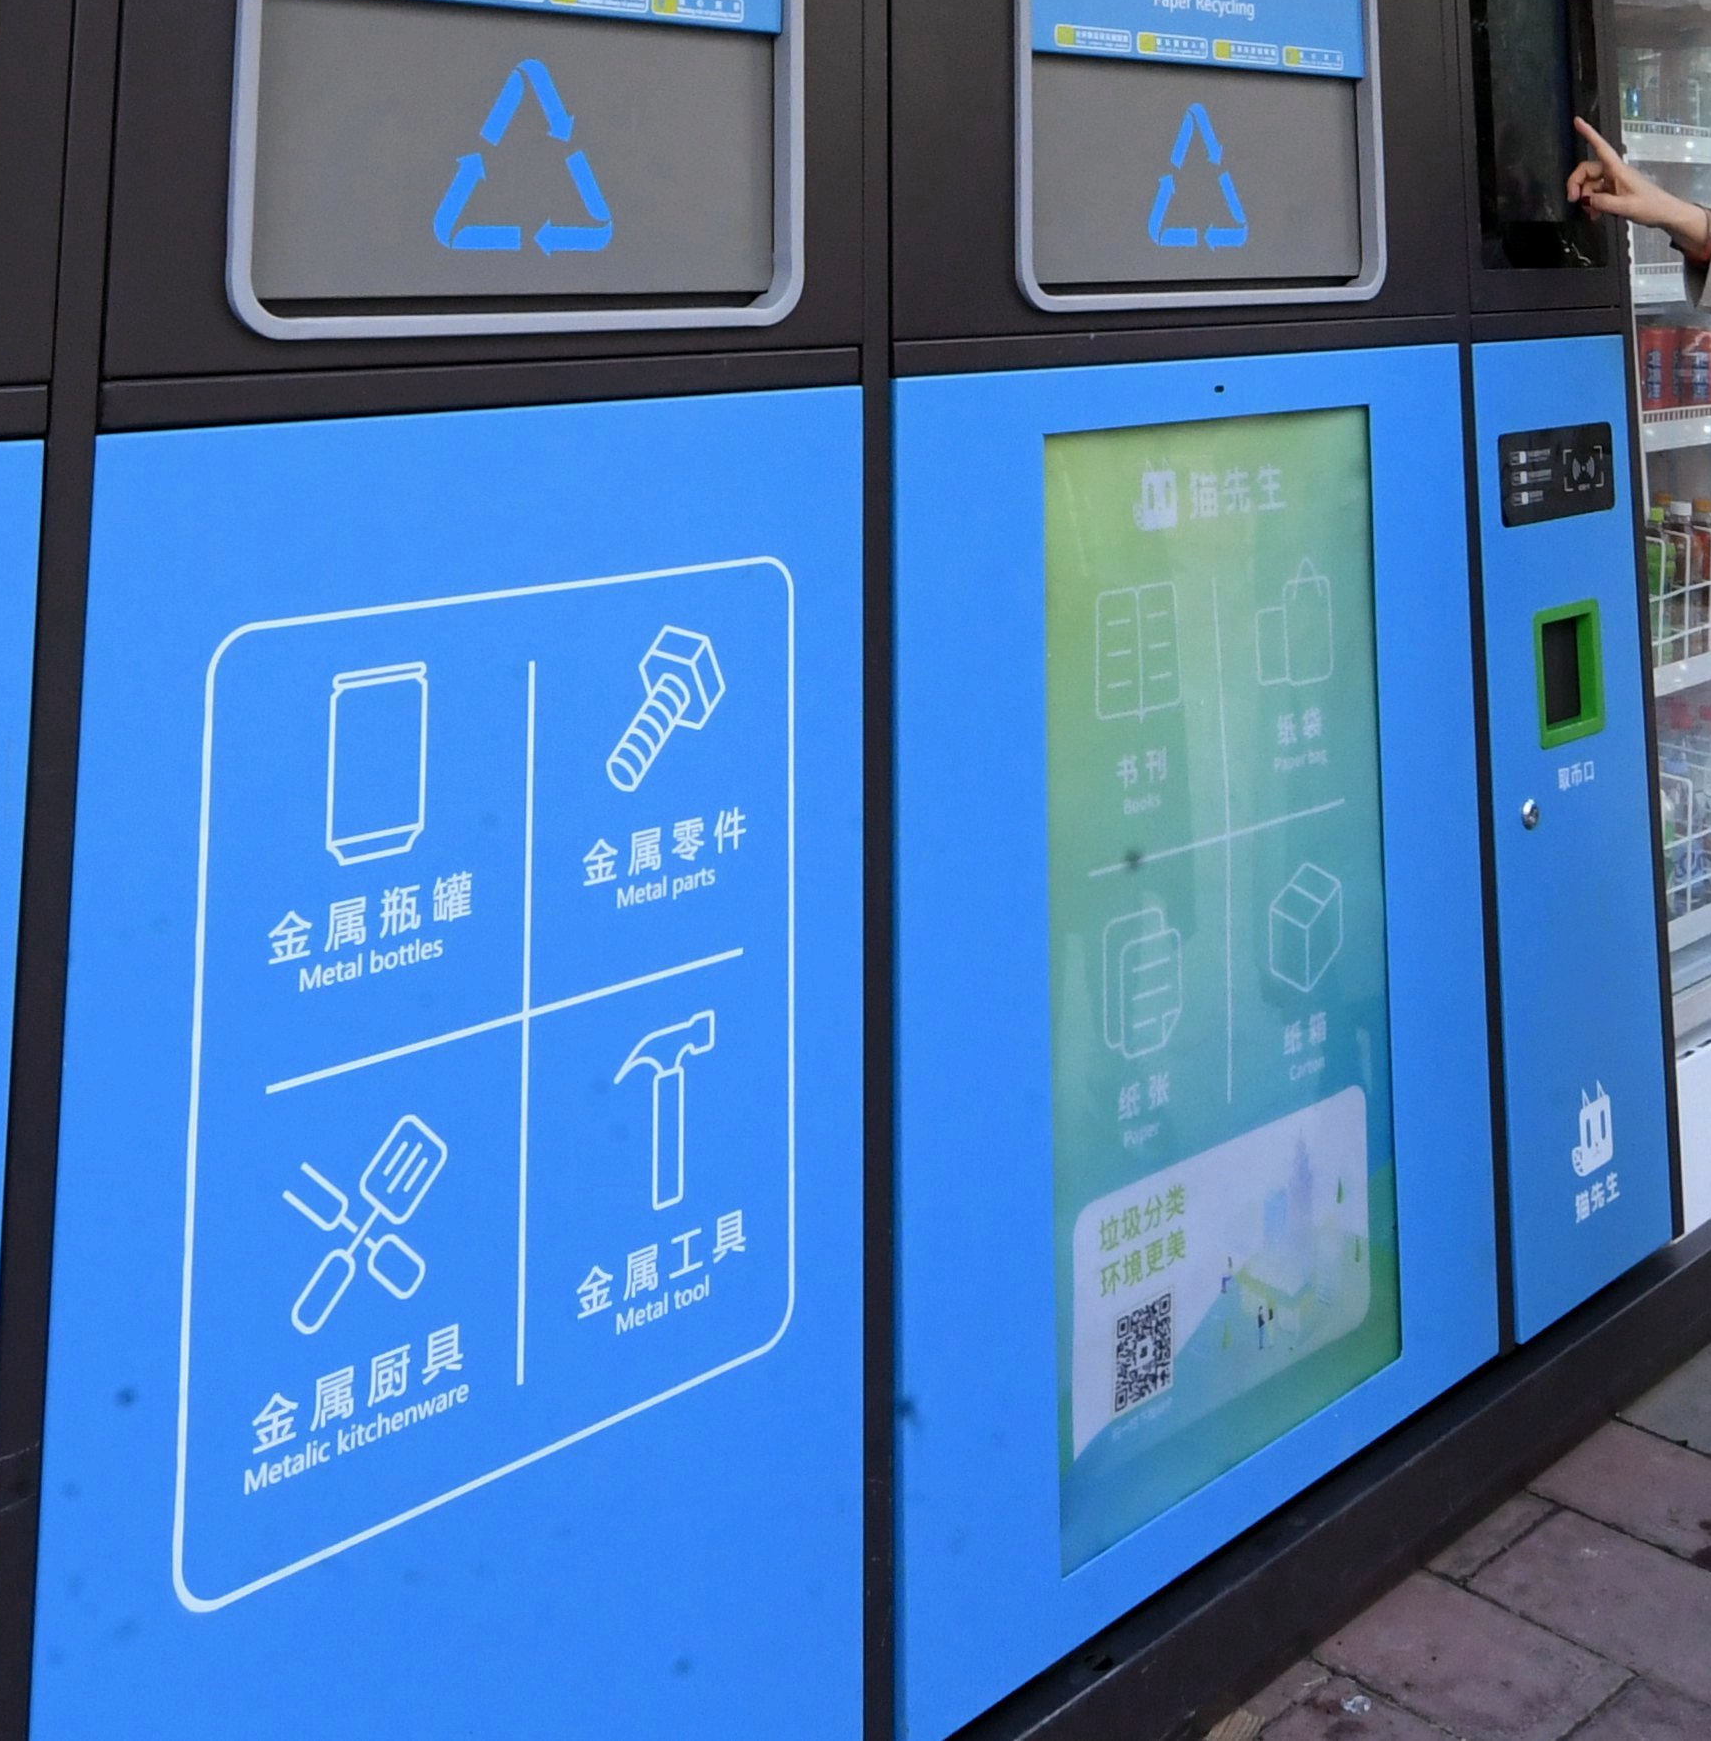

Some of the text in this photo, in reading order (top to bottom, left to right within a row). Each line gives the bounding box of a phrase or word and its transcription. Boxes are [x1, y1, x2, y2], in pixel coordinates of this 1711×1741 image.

[1116, 746, 1169, 789] 书刊
[1123, 792, 1162, 816] Books
[582, 806, 749, 888] 金属零件
[267, 870, 475, 966] 金属瓶罐
[615, 864, 717, 912] Metal parts
[298, 933, 445, 994] Metal bottles
[1116, 1069, 1172, 1123] 纸张
[1098, 1181, 1187, 1254] 垃圾分类
[575, 1210, 749, 1321] 金属工具
[1099, 1226, 1187, 1299] 环境更美
[615, 1272, 711, 1337] Metal tool
[251, 1323, 465, 1454] 金属厨具
[242, 1381, 471, 1496] Metalic kitchenware
